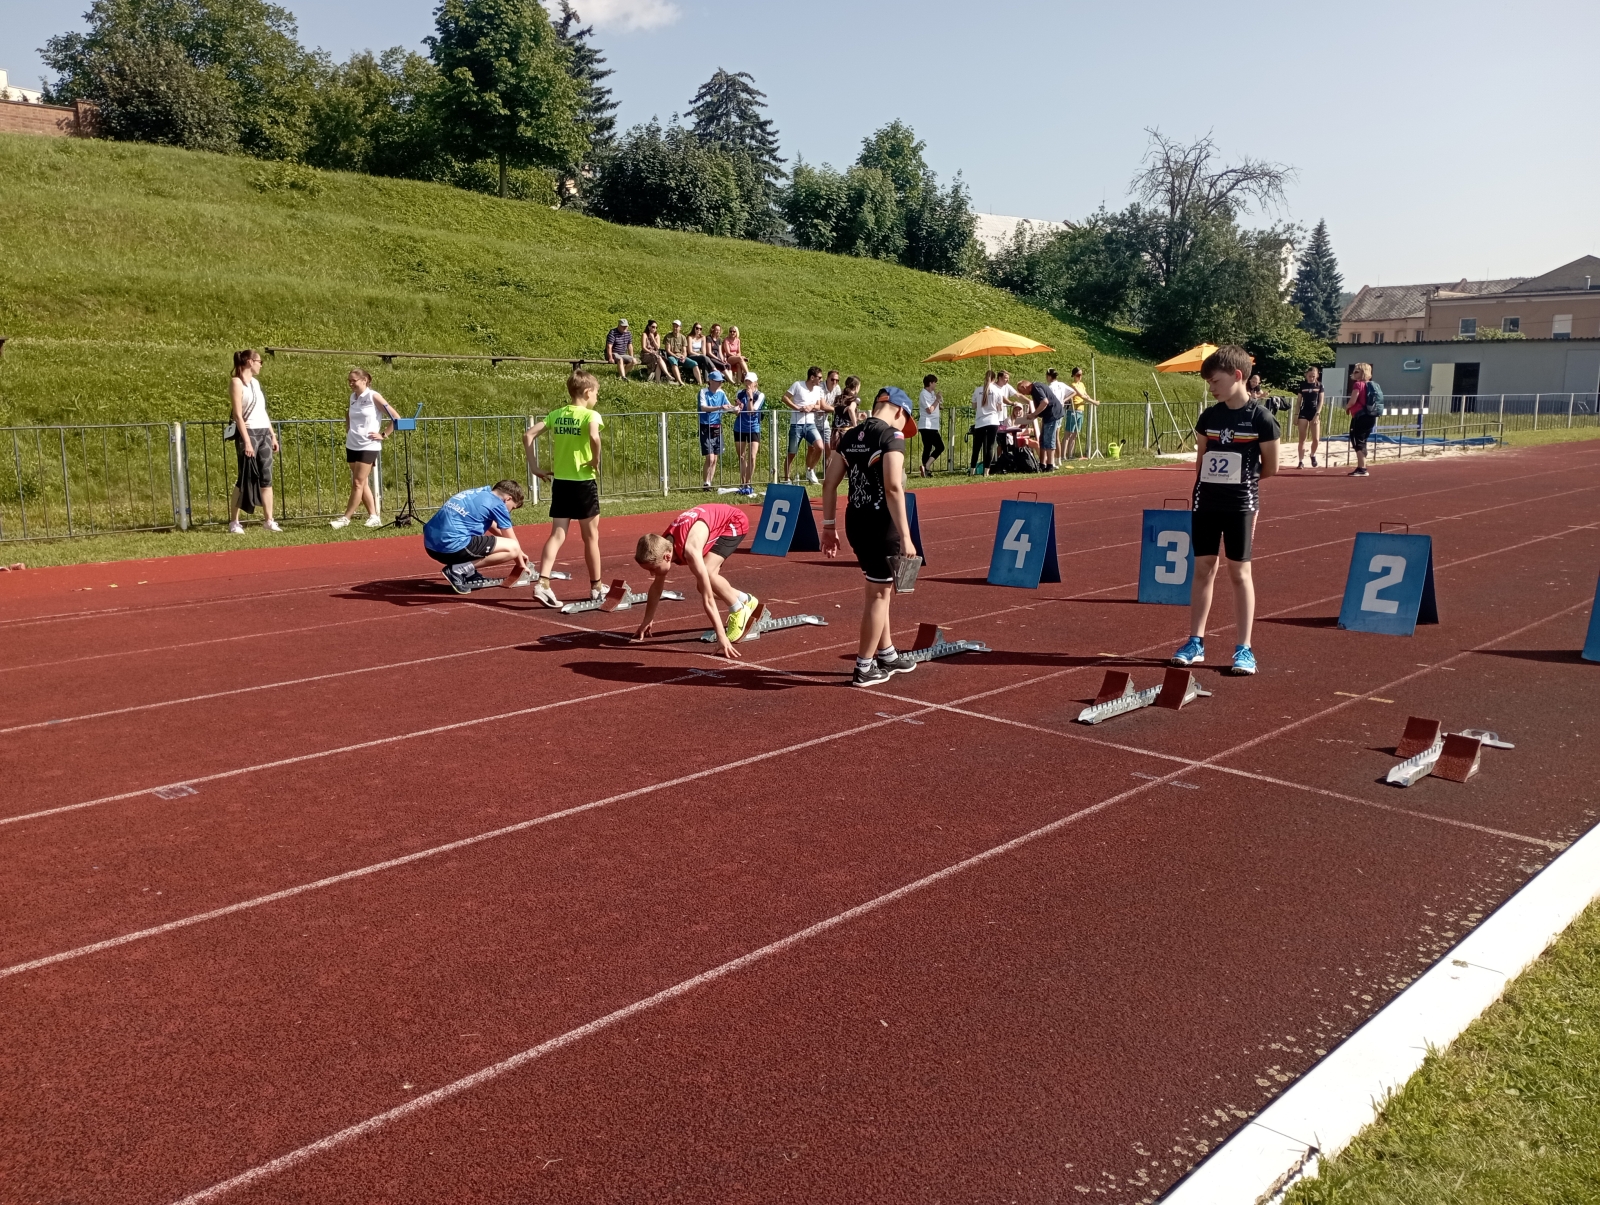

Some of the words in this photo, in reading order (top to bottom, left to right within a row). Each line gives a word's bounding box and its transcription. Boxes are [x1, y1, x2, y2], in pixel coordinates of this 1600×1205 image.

[555, 417, 580, 426] ATLETIKA
[1209, 457, 1229, 474] 32
[765, 499, 790, 541] 6
[1002, 518, 1032, 569] 4
[1154, 530, 1190, 585] 3
[1360, 554, 1407, 614] 2
